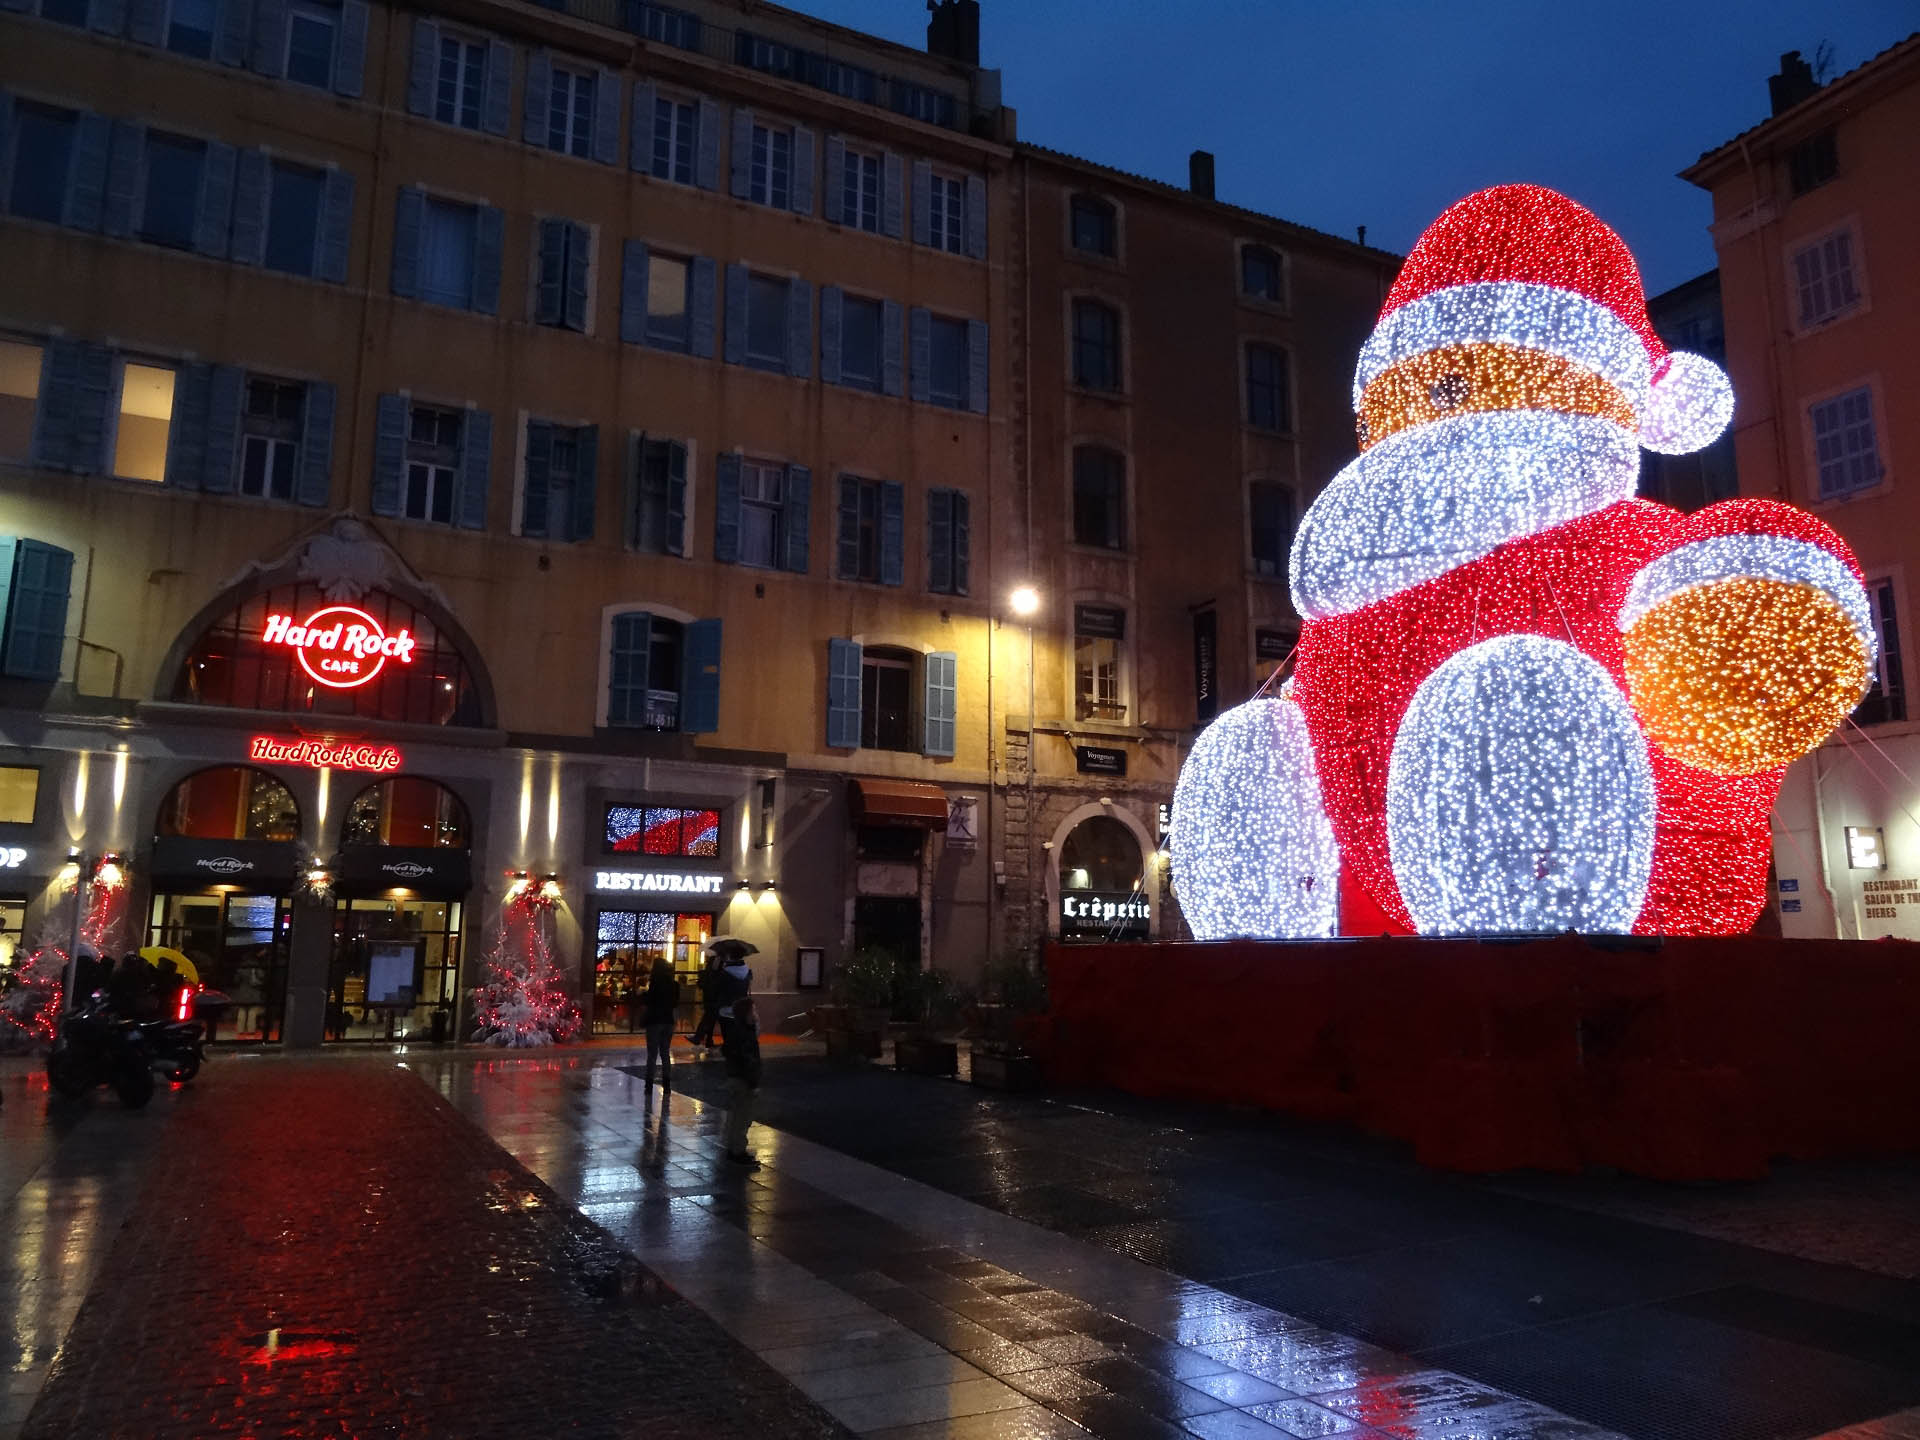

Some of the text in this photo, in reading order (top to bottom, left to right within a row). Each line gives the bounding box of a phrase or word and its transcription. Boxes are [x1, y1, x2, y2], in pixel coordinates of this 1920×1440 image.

[263, 615, 414, 663] Hard Rock
[321, 659, 359, 674] CAFE
[252, 738, 400, 772] Hard Rock Cafe
[196, 859, 255, 870] Hard Rock
[408, 865, 434, 873] Rock
[596, 872, 723, 892] RESTAURANT
[1863, 879, 1918, 891] RESTAURANT
[1865, 894, 1892, 905] SALON
[1894, 893, 1905, 904] DE
[1063, 896, 1151, 921] Crêperie
[1866, 907, 1897, 919] BIERES
[1077, 919, 1133, 928] RESTAURANT
